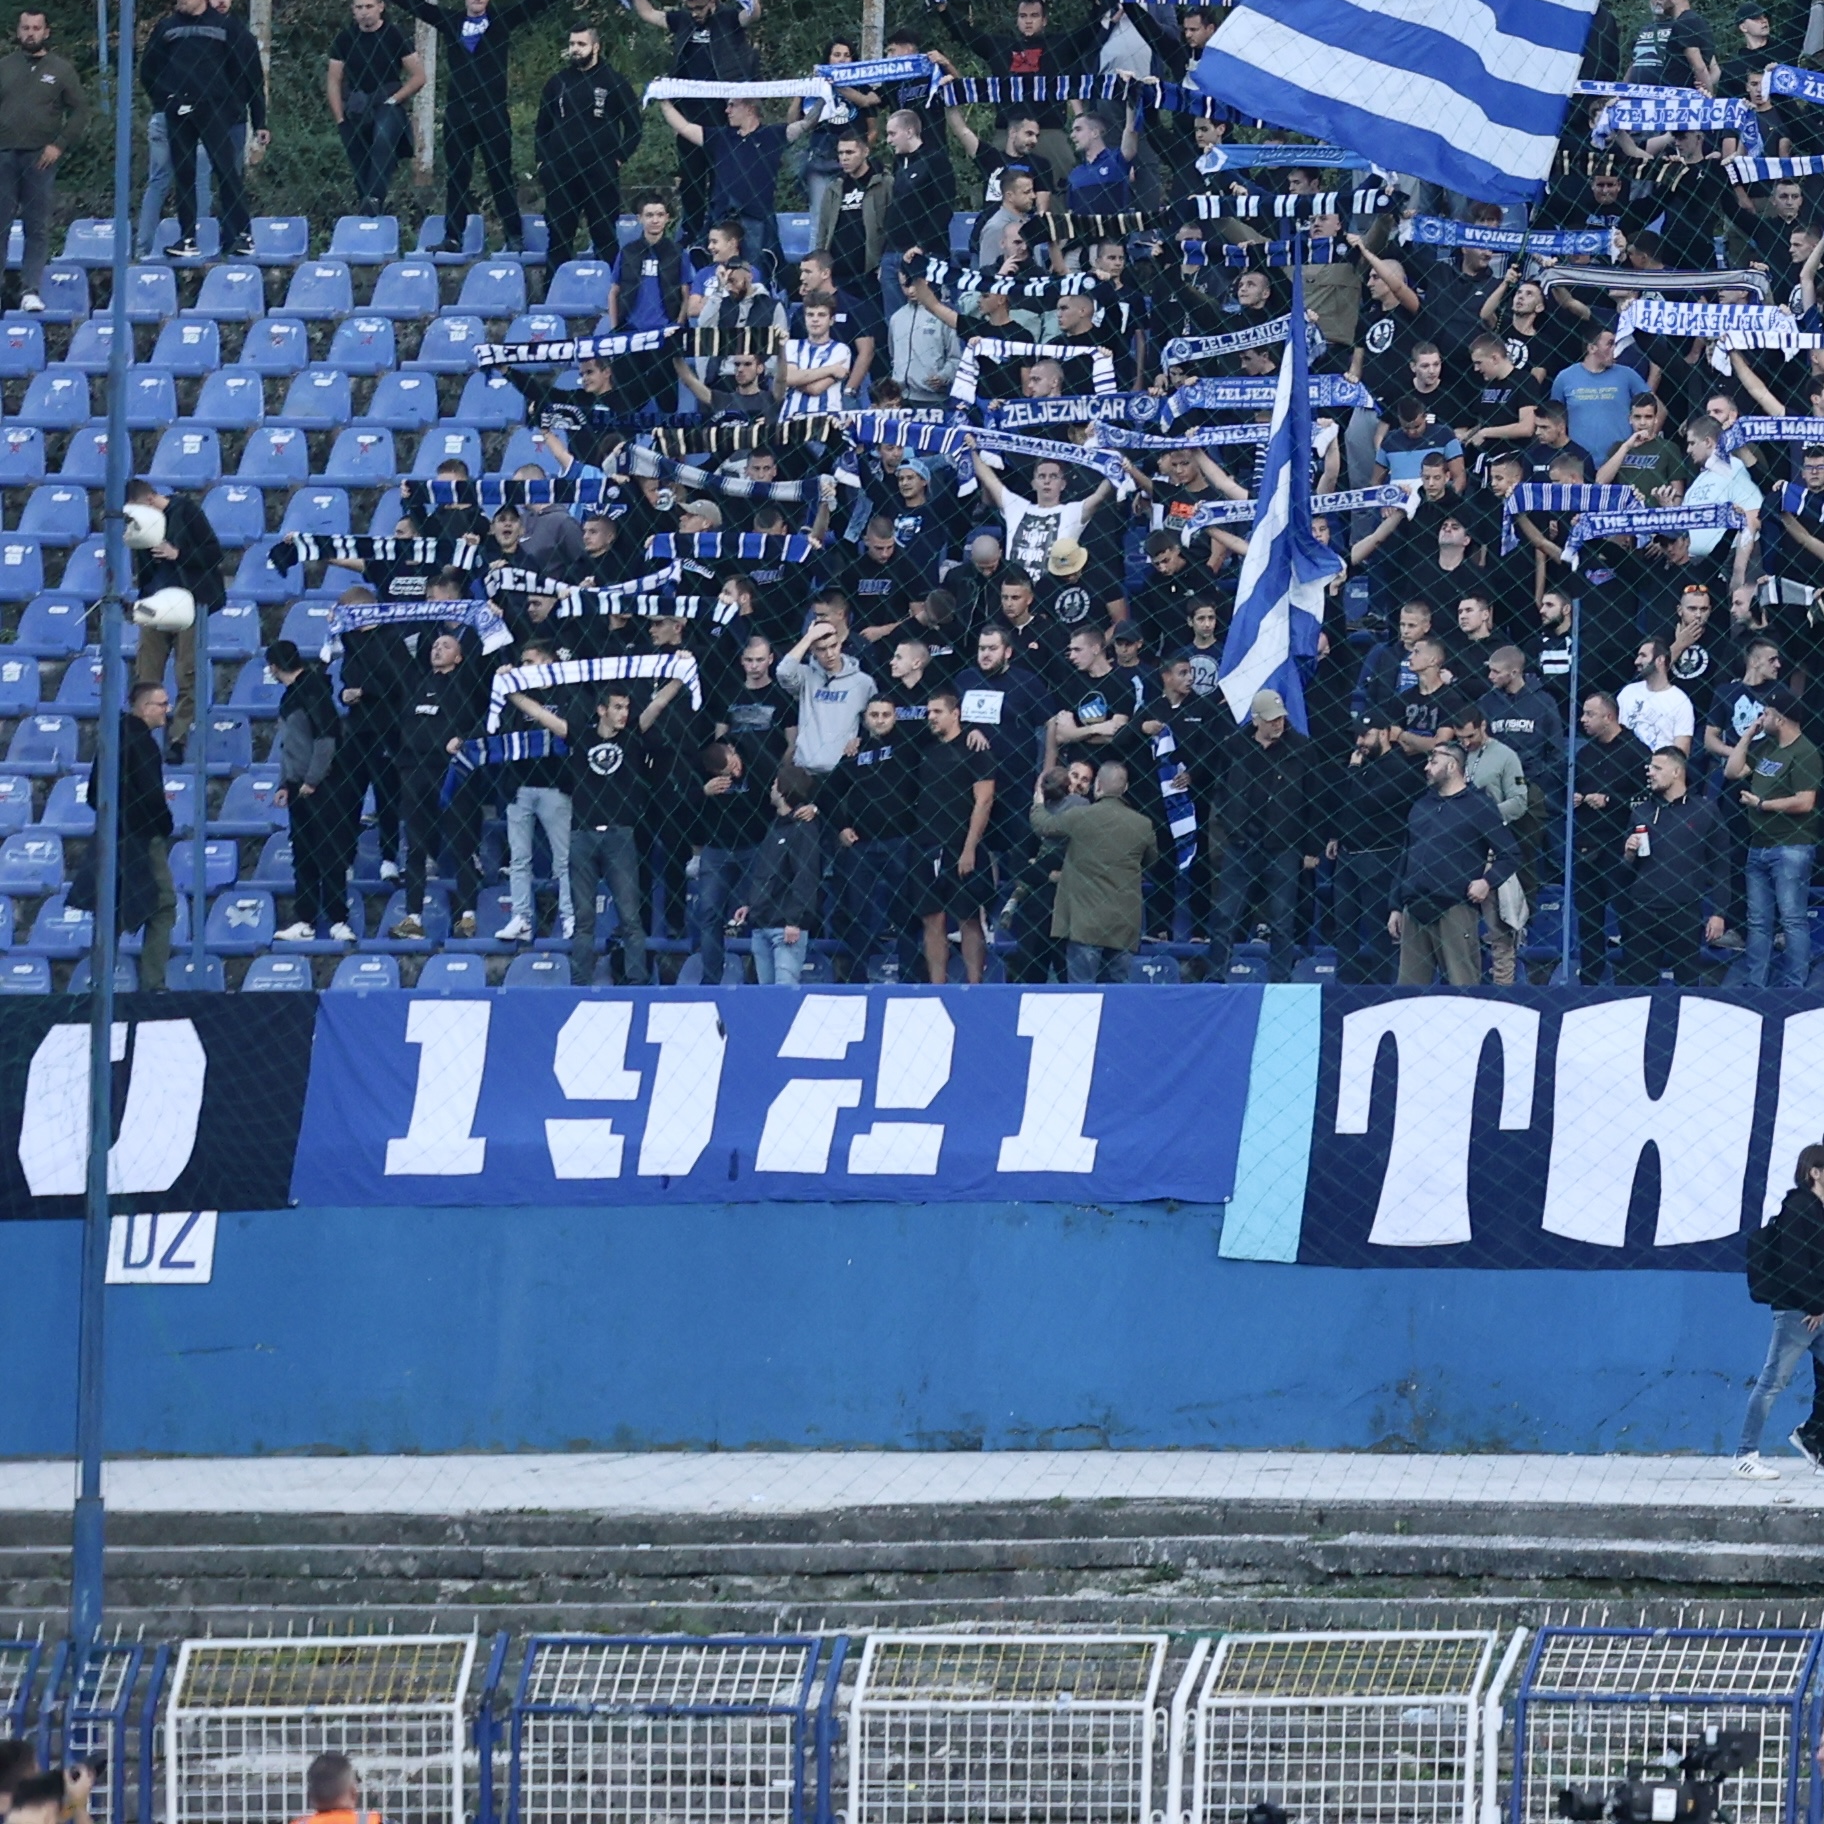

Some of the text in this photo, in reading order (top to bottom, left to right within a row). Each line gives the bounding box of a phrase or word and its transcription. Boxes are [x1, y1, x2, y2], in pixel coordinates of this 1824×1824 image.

[1589, 508, 1717, 529] THE MANIACS
[384, 991, 1106, 1180] 1921
